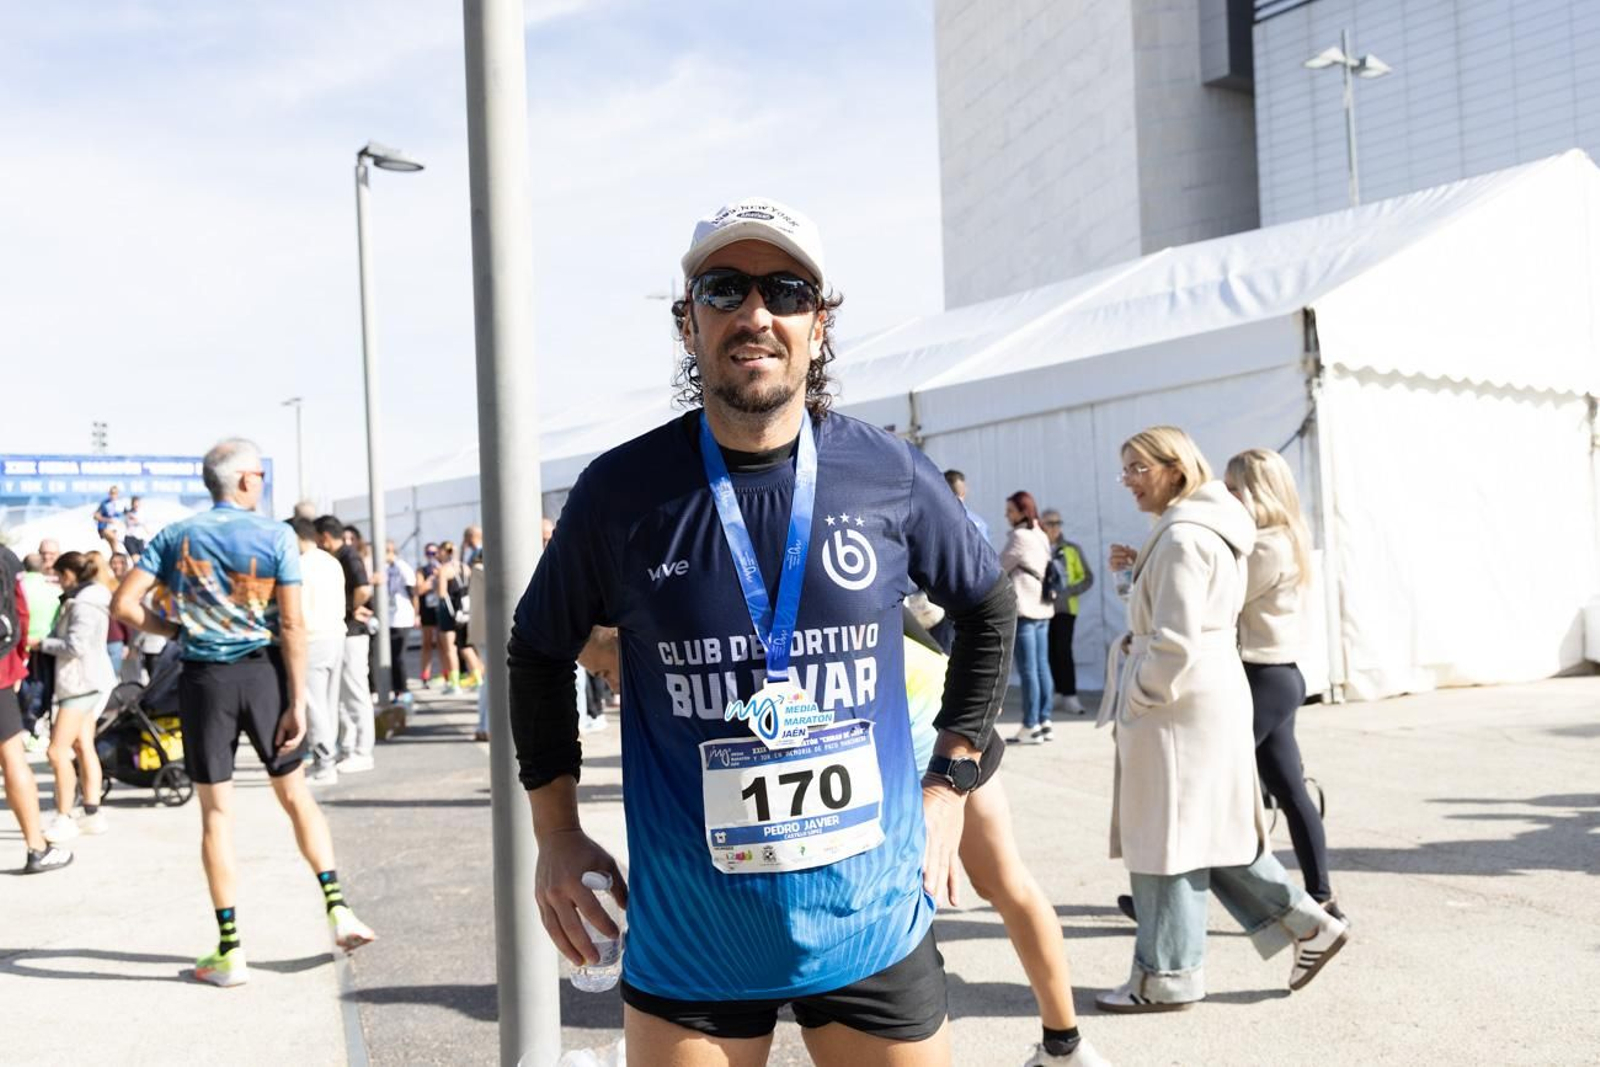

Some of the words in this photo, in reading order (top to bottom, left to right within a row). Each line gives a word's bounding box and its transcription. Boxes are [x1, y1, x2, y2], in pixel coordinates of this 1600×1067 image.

[657, 637, 723, 666] CLUB
[729, 623, 879, 662] DEORTIVO
[785, 704, 817, 714] MEDIA
[782, 727, 806, 739] JAÉN
[741, 764, 852, 822] 170
[763, 821, 800, 837] PEDRO
[804, 815, 840, 831] JAVIER
